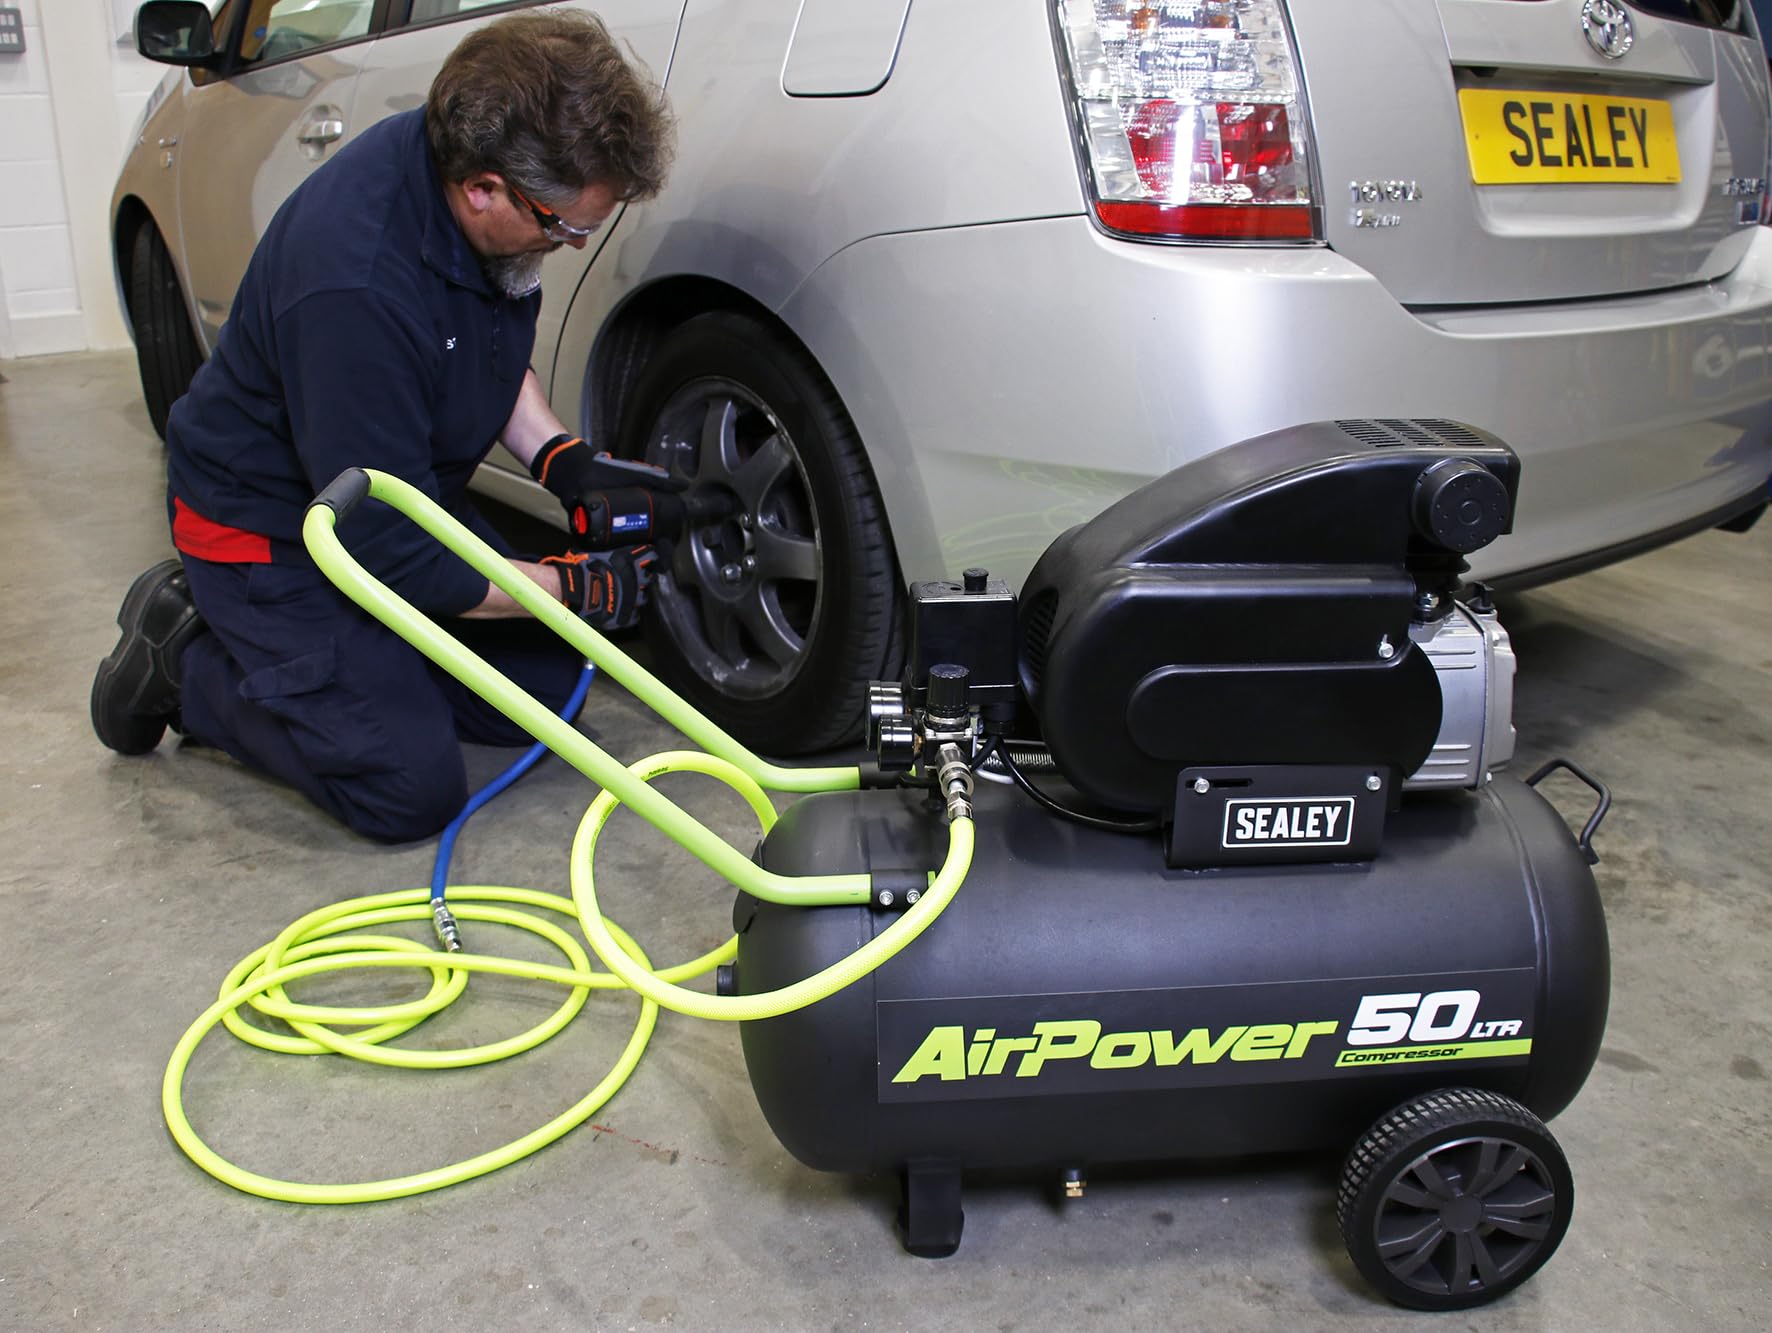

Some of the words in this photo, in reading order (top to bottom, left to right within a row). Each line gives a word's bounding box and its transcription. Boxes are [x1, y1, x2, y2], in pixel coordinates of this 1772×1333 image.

[1503, 101, 1649, 168] SEALEY
[1235, 806, 1343, 840] SEALEY
[891, 1019, 1339, 1083] AirPower
[1347, 989, 1481, 1046] 50
[1469, 1019, 1523, 1038] LTR
[1341, 1048, 1463, 1063] Compressor
